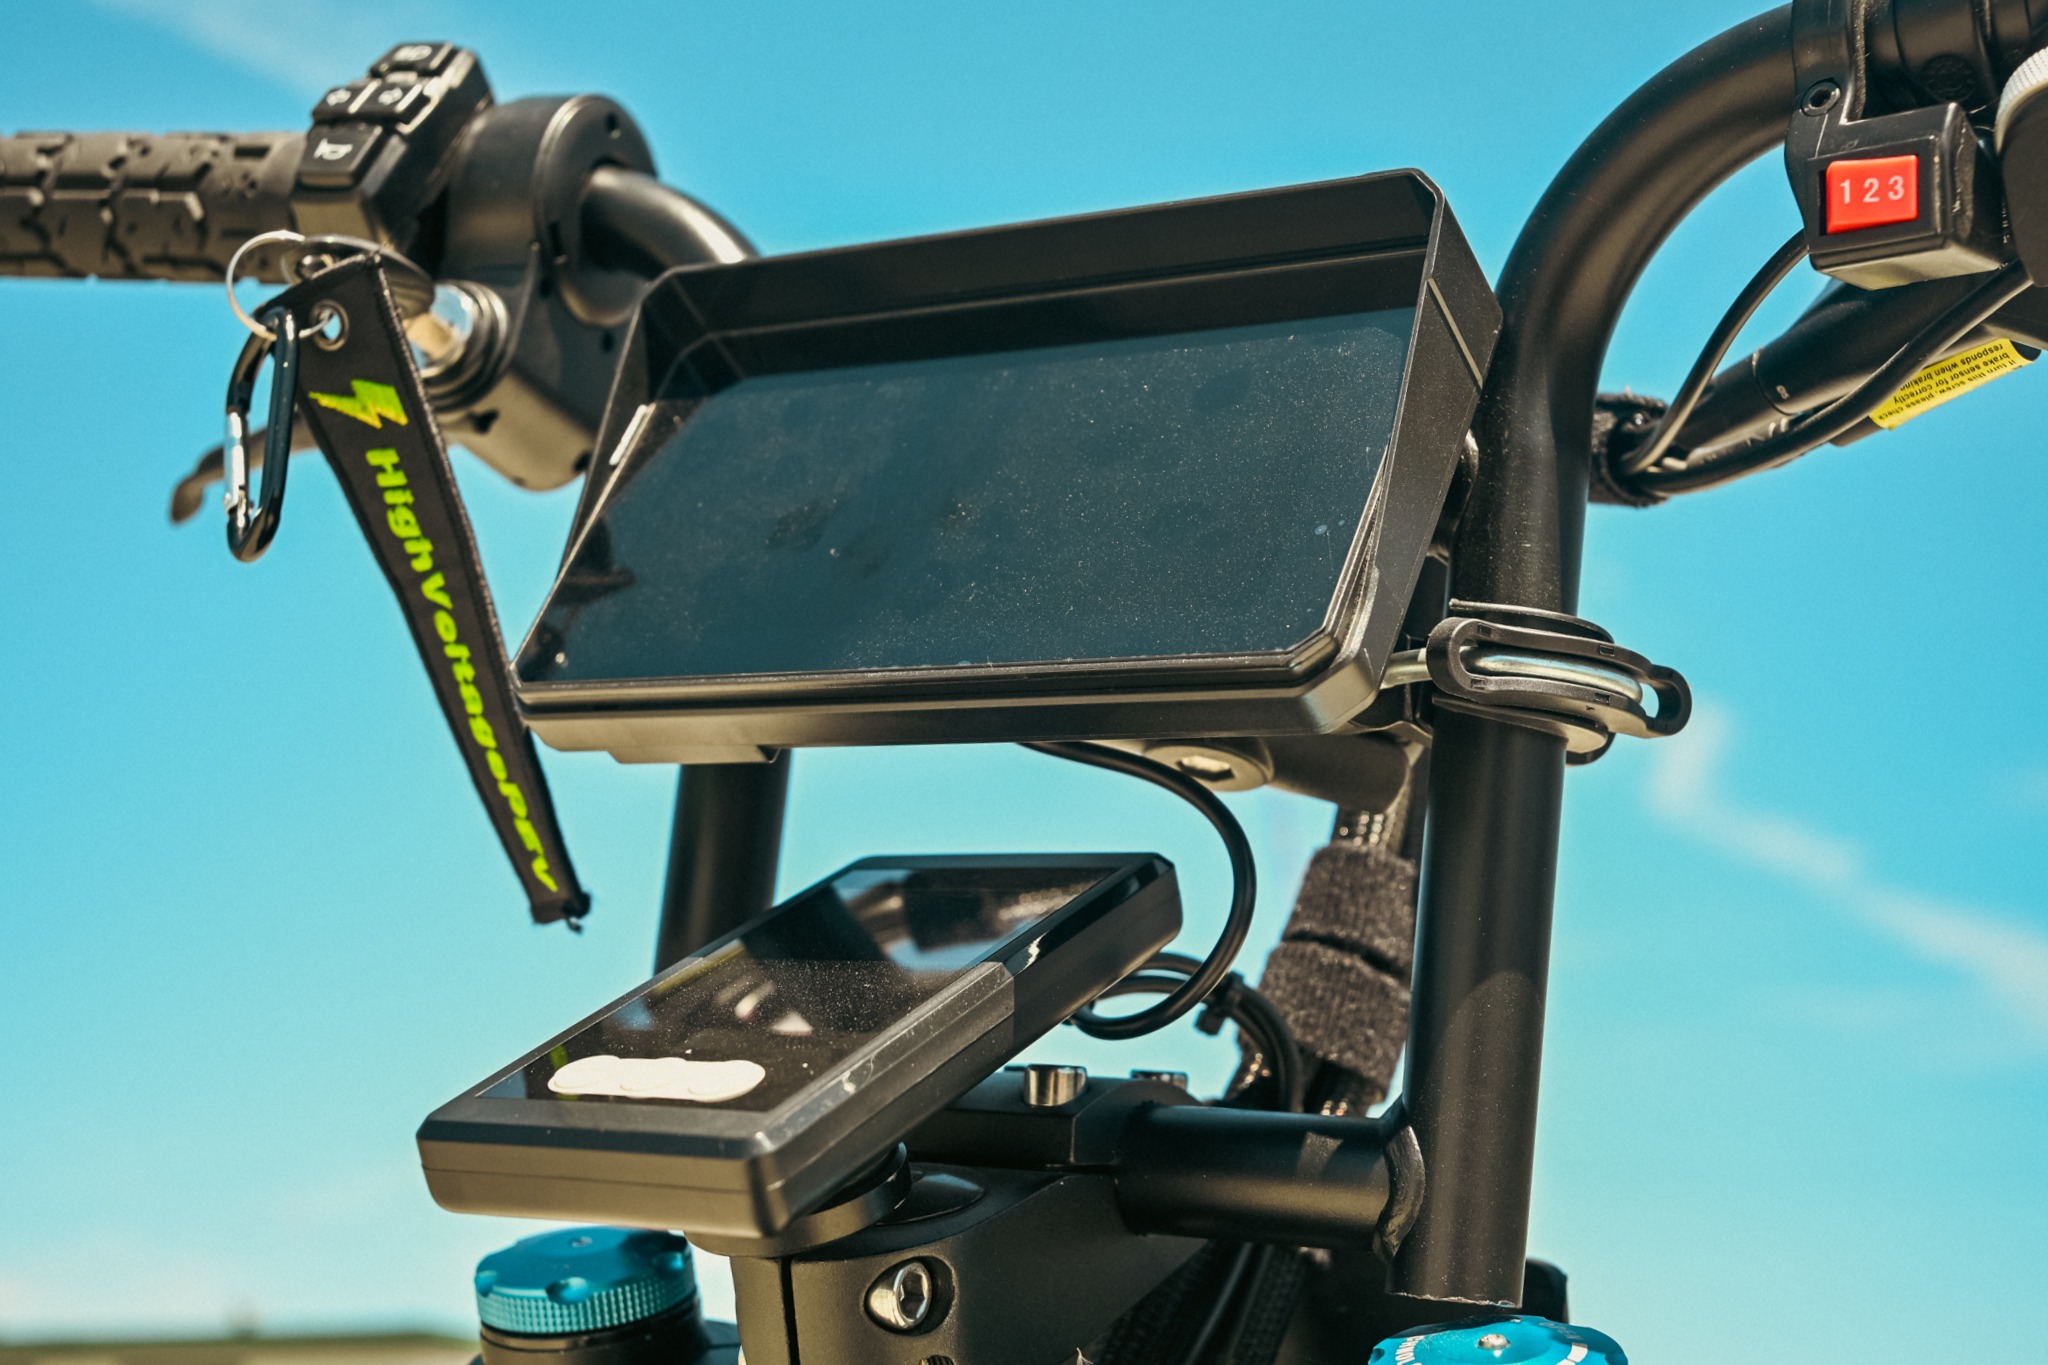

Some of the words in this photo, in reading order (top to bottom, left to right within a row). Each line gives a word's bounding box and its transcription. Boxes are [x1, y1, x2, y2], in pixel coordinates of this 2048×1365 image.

[1960, 343, 2004, 365] responds
[1982, 352, 2011, 367] brake
[1934, 362, 1959, 376] when
[1950, 364, 1982, 381] sensor
[1935, 377, 1949, 388] for
[1893, 384, 1933, 405] correctly
[1905, 392, 1935, 409] please
[1878, 406, 1904, 420] check
